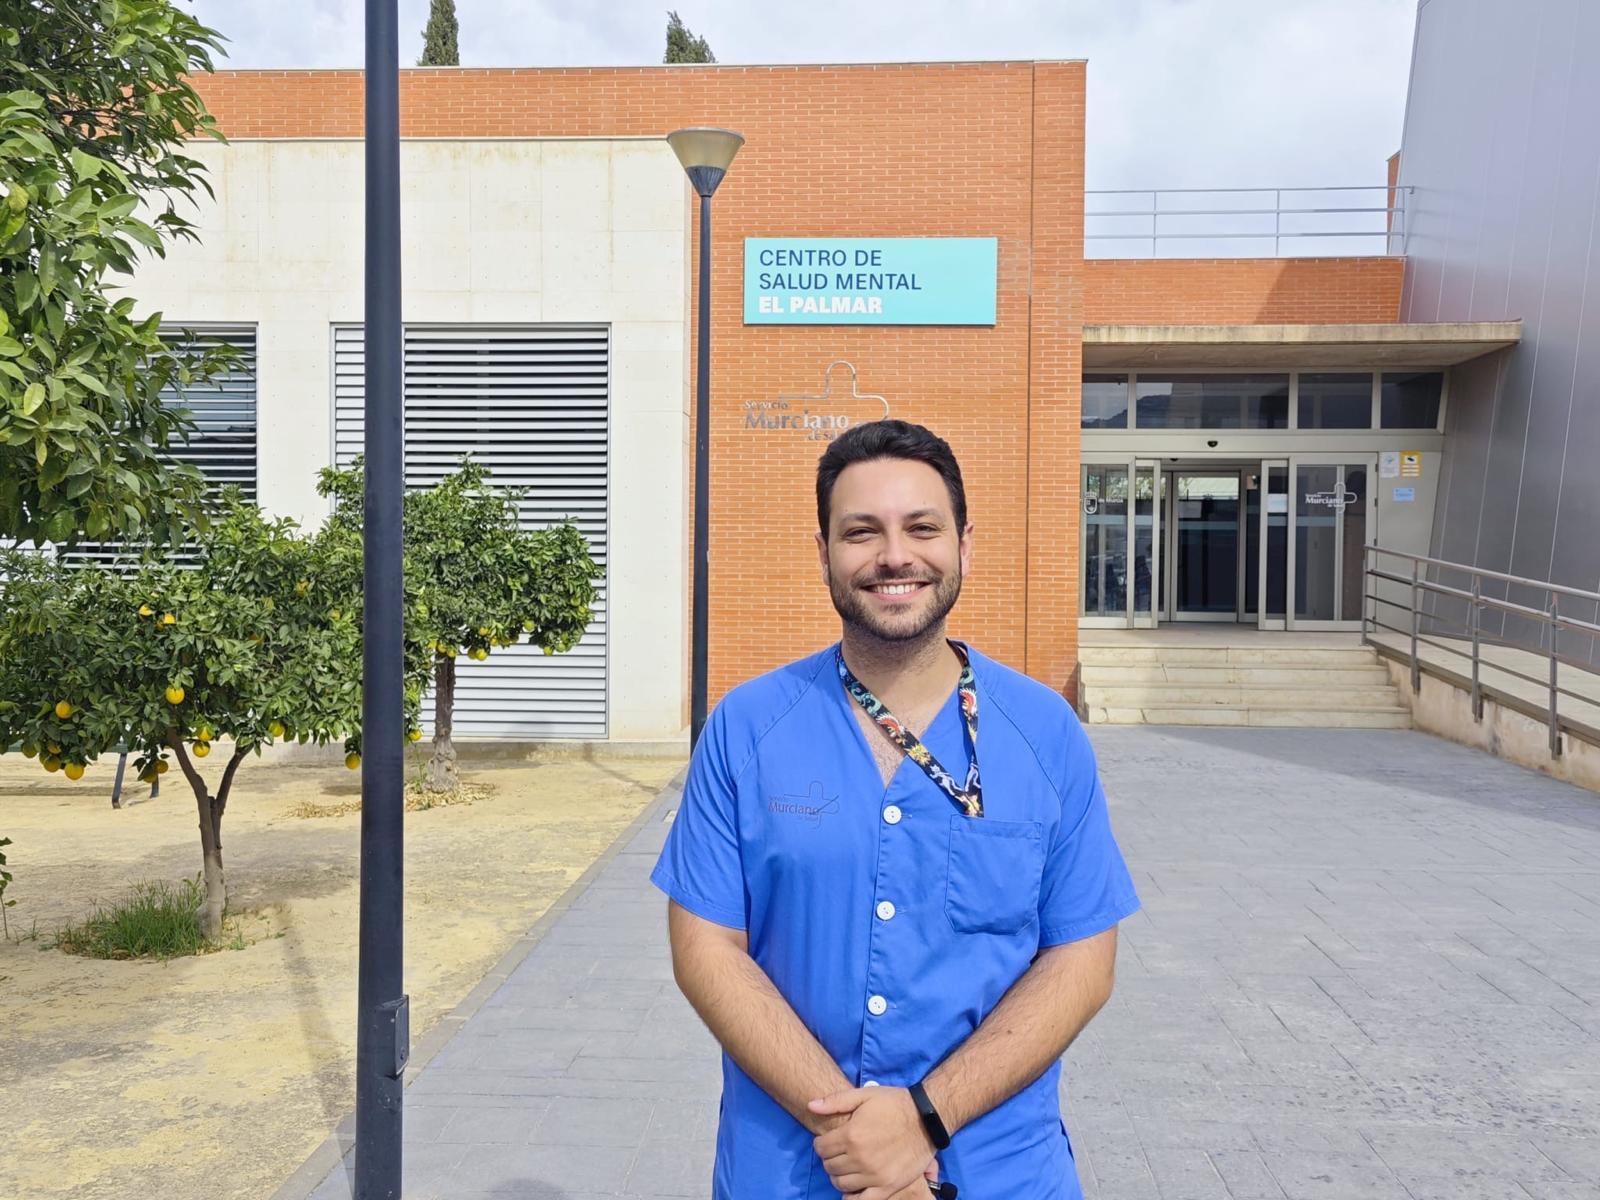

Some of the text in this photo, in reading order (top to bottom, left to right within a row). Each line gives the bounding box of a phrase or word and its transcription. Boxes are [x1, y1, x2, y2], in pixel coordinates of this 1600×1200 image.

[759, 249, 882, 266] CENTRO DE
[759, 273, 922, 290] SALUD MENTAL
[758, 296, 882, 314] EL PALMAR
[745, 409, 849, 429] Murciano
